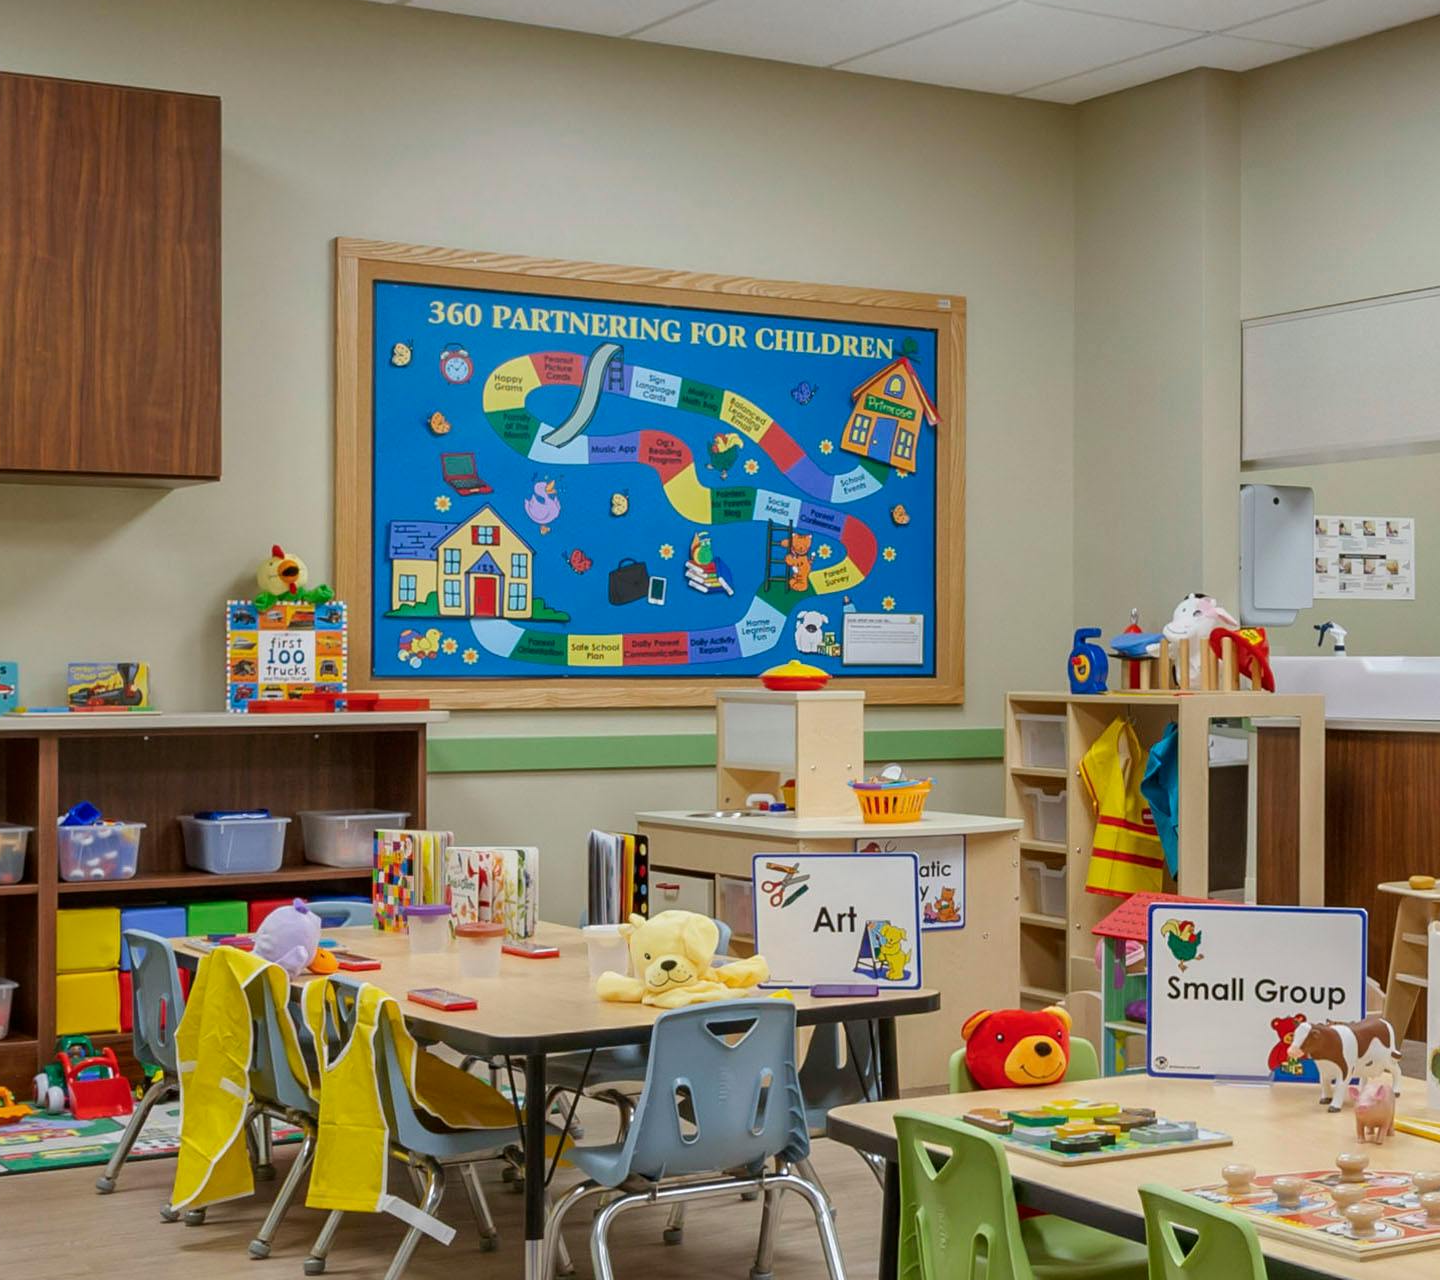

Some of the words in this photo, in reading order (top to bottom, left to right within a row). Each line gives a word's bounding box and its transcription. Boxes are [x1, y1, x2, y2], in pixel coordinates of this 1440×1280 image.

[428, 300, 482, 327] 360
[492, 305, 681, 344] PARTNERING
[690, 321, 747, 349] FOR
[755, 327, 894, 360] CHILDREN
[544, 354, 573, 365] Peanut
[544, 363, 572, 373] Picture
[494, 373, 523, 385] Happy
[546, 371, 571, 381] Cards
[648, 374, 666, 386] Sign
[494, 383, 523, 393] Grams
[635, 380, 676, 396] Language
[642, 389, 666, 403] Cards
[730, 396, 767, 426] Balanced
[868, 395, 914, 419] Primrose
[728, 405, 762, 432] Learning
[730, 414, 752, 434] Email
[591, 444, 616, 455] Music
[619, 444, 637, 456] App
[648, 446, 682, 457] Reading
[648, 455, 682, 466] Program
[839, 474, 866, 488] School
[843, 482, 867, 496] Events
[767, 496, 791, 509] Social
[765, 505, 789, 518] Media
[810, 508, 835, 521] Parent
[824, 566, 847, 579] Parent
[825, 575, 850, 587] Survey
[745, 618, 771, 628] Home
[741, 625, 776, 636] Learning
[271, 637, 302, 649] first
[528, 638, 556, 648] Parent
[690, 637, 707, 648] Daily
[707, 636, 736, 648] Activity
[752, 632, 768, 642] Fun
[570, 642, 590, 652] Safe
[592, 642, 620, 653] School
[631, 638, 651, 650] Daily
[654, 638, 680, 648] Parent
[699, 644, 729, 655] Reports
[267, 648, 305, 665] 100
[517, 647, 564, 657] Orientation
[586, 651, 605, 661] Plan
[623, 648, 688, 659] Communication
[266, 664, 308, 676] trucks
[813, 906, 858, 933] Art
[1167, 976, 1244, 1002] Small
[1255, 978, 1347, 1010] Group
